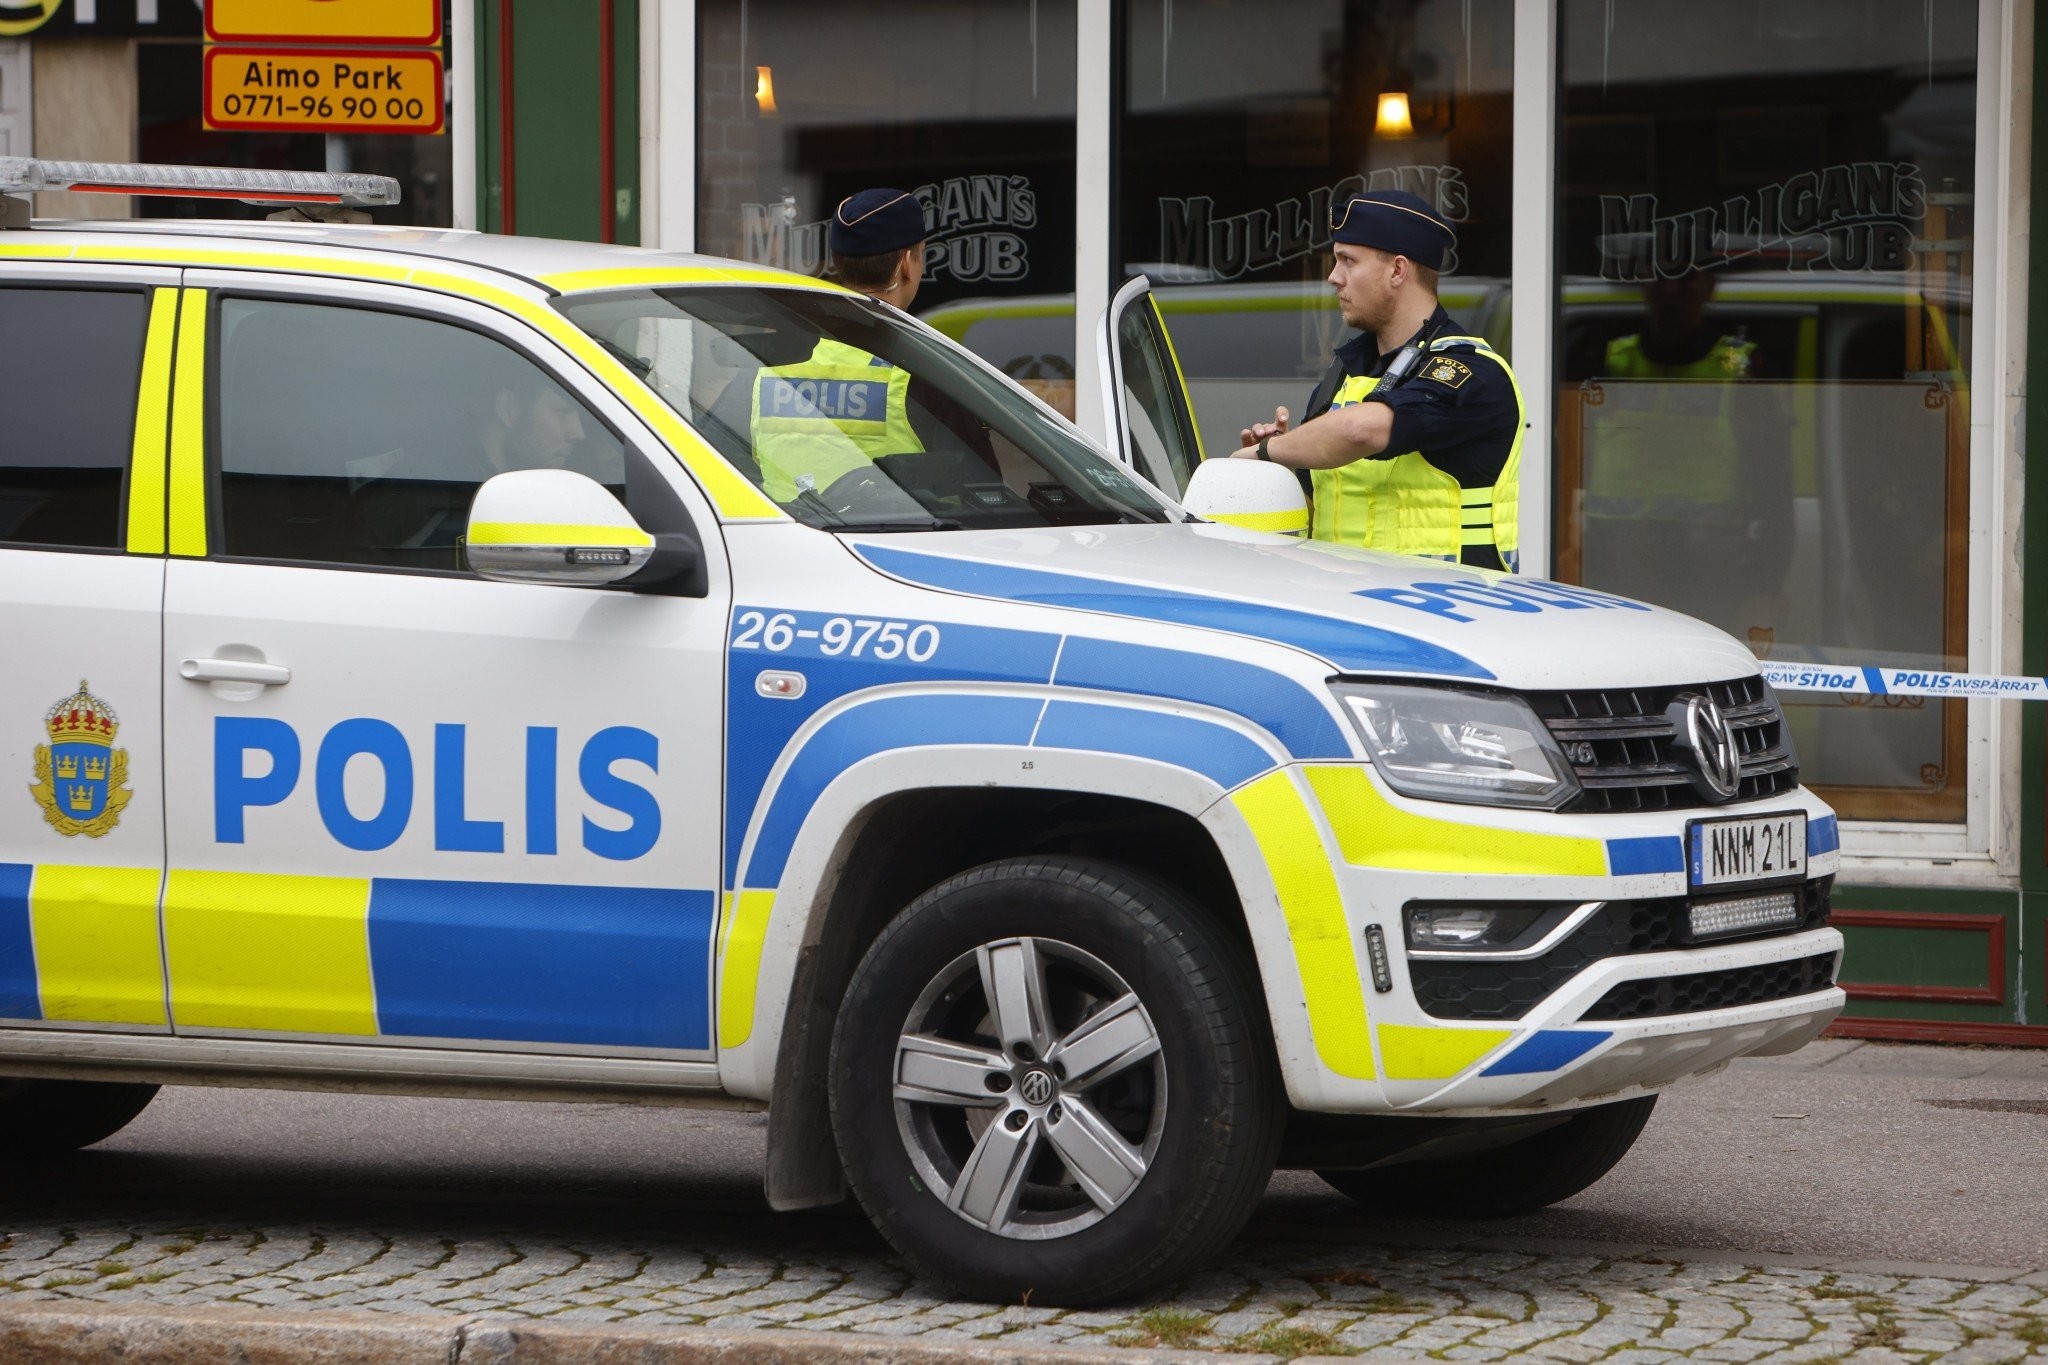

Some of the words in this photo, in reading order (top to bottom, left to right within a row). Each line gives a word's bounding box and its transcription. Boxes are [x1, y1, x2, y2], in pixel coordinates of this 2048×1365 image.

[243, 61, 320, 88] Aimo
[333, 63, 403, 90] Park
[223, 94, 333, 118] 0771-96
[341, 97, 377, 119] 90
[385, 98, 423, 120] 00
[921, 231, 1030, 283] PUB
[1786, 221, 1917, 273] PUB
[1436, 358, 1468, 375] POLIS
[772, 380, 869, 418] POLIS
[1350, 580, 1653, 623] POLIS
[731, 611, 941, 662] 26-9750
[1798, 672, 1857, 689] POLIS
[1892, 672, 1953, 688] POLIS
[1952, 678, 2040, 691] AVSPÄRRAT
[213, 716, 662, 861] POLIS
[1712, 825, 1755, 877] NNM
[1761, 821, 1797, 872] 21L
